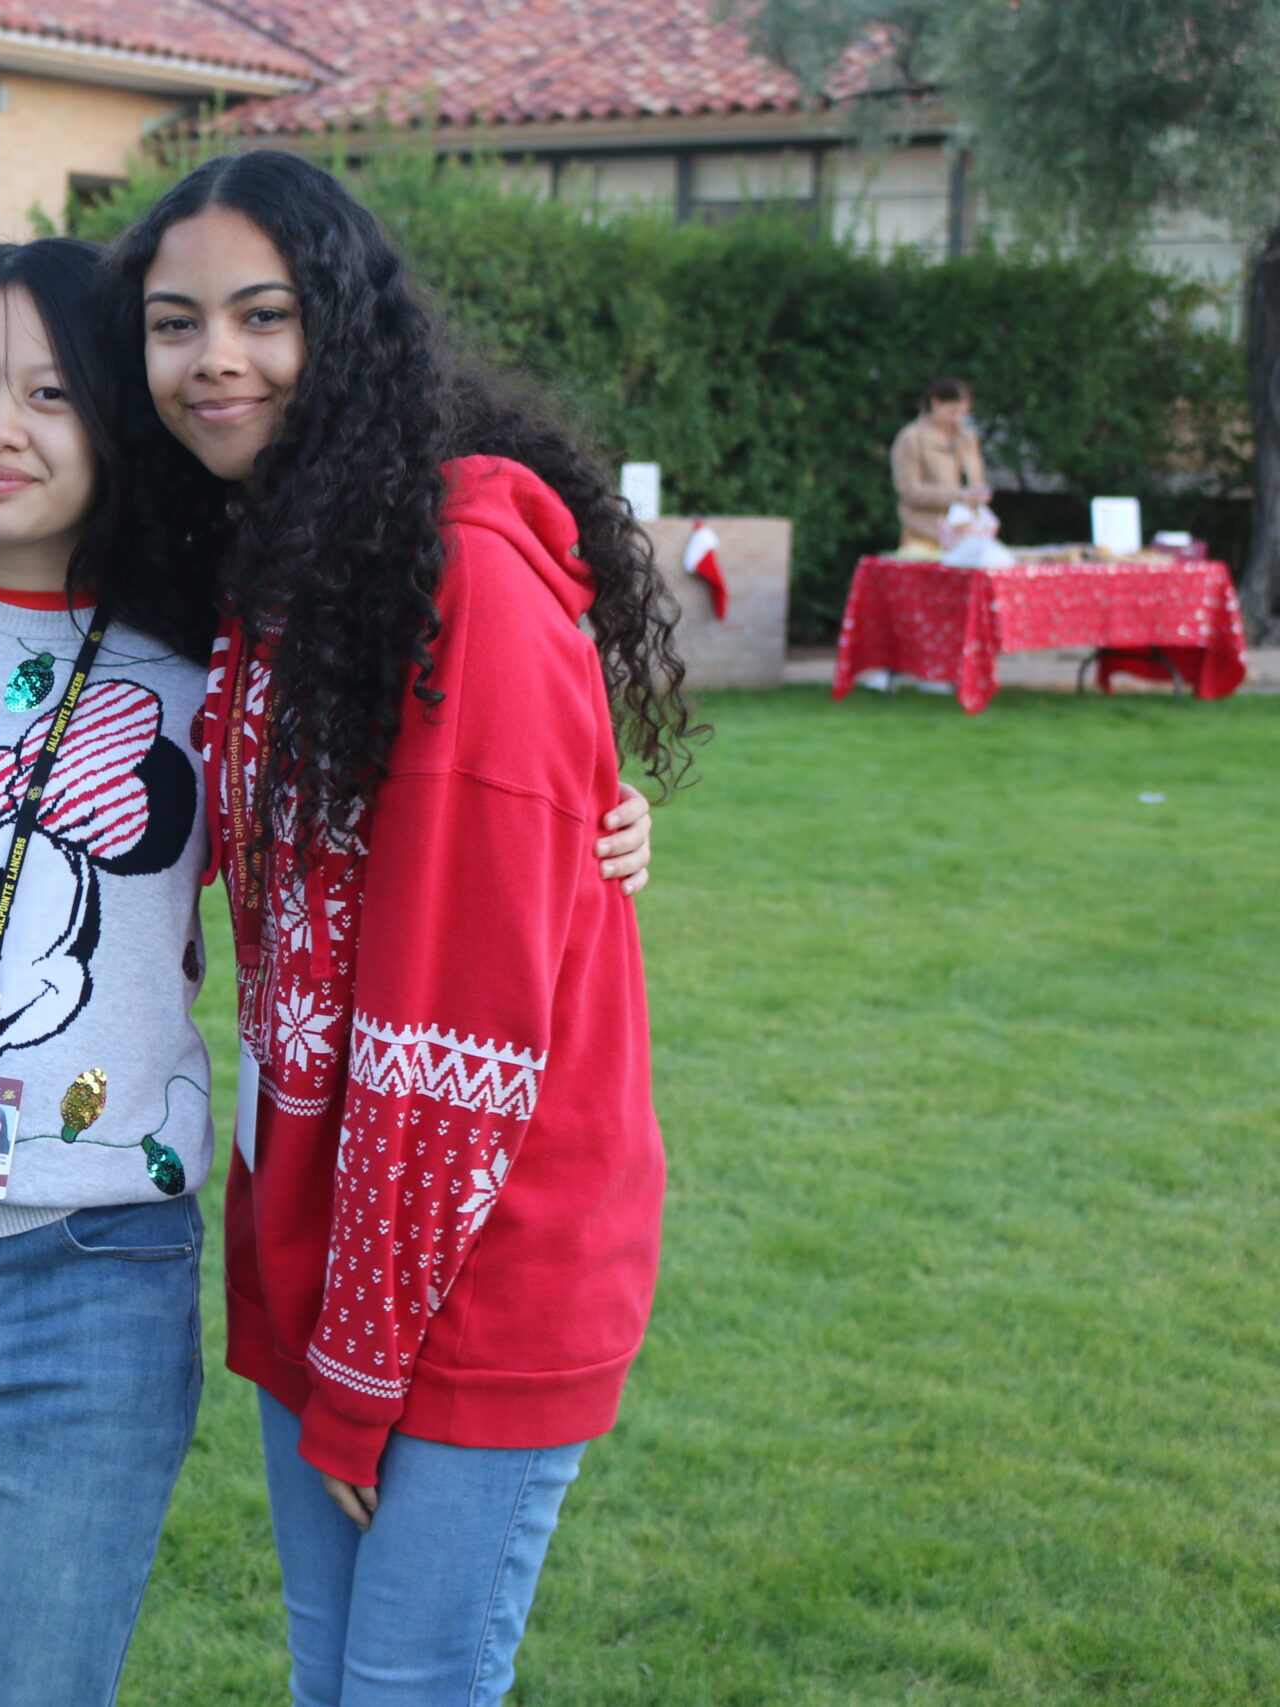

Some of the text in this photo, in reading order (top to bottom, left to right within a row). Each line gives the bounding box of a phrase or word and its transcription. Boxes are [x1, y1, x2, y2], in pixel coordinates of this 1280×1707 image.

[46, 672, 86, 753] SALPOINTE LANCERS
[230, 727, 241, 784] Salpointe
[7, 837, 27, 880] LANCERS
